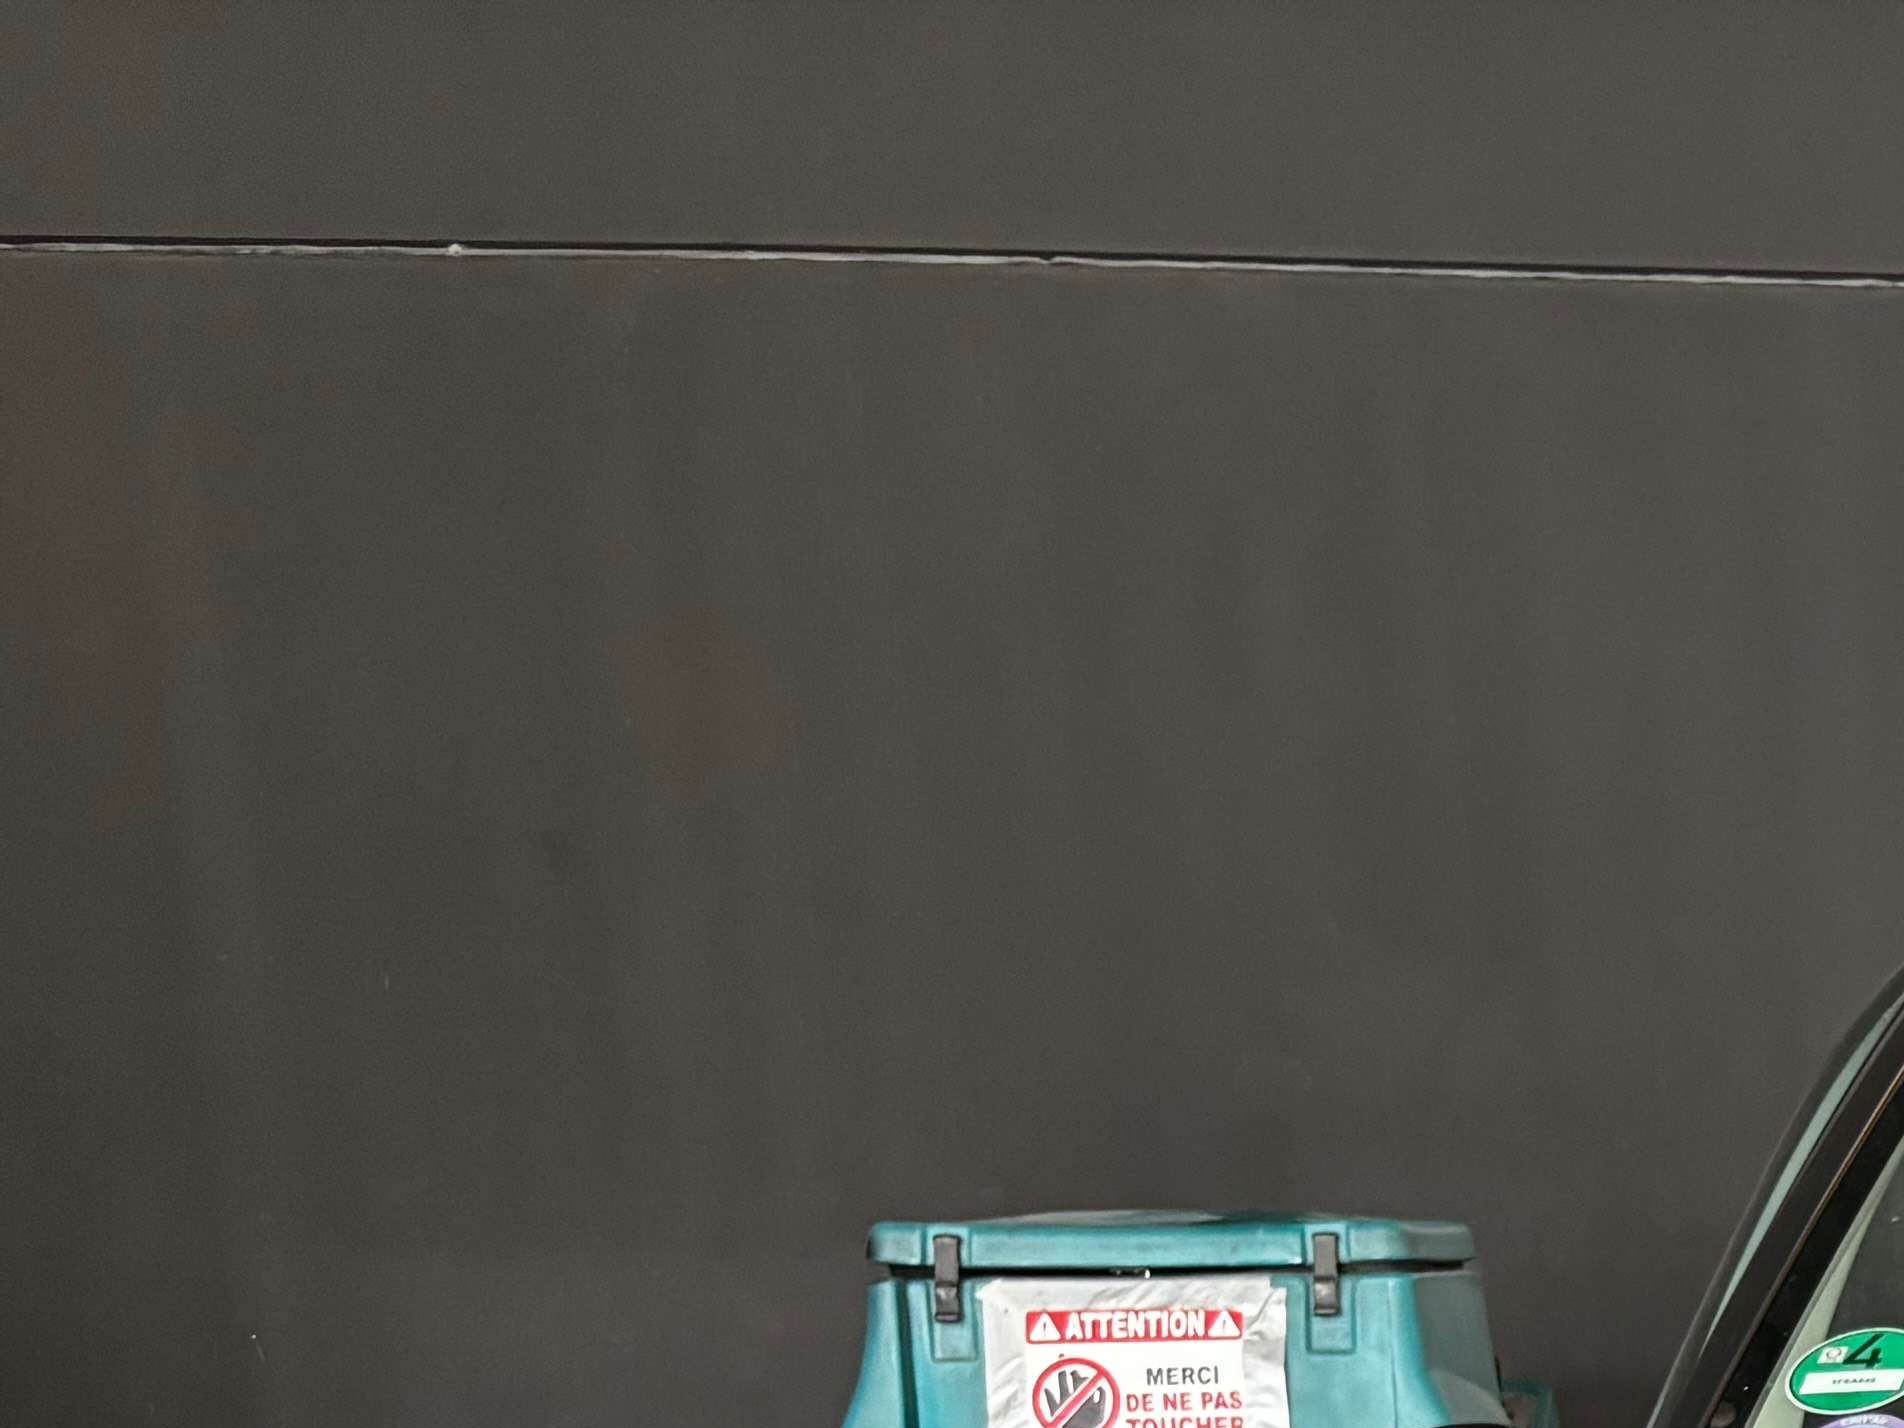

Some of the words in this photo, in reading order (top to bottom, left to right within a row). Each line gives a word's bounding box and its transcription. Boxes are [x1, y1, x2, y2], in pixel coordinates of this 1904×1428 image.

[1065, 1310, 1206, 1340] ATTENTION
[1843, 1333, 1886, 1369] 4
[1146, 1366, 1220, 1386] MERCI
[1126, 1393, 1153, 1412] DE
[1163, 1392, 1193, 1412] NE
[1201, 1390, 1243, 1411] PAS
